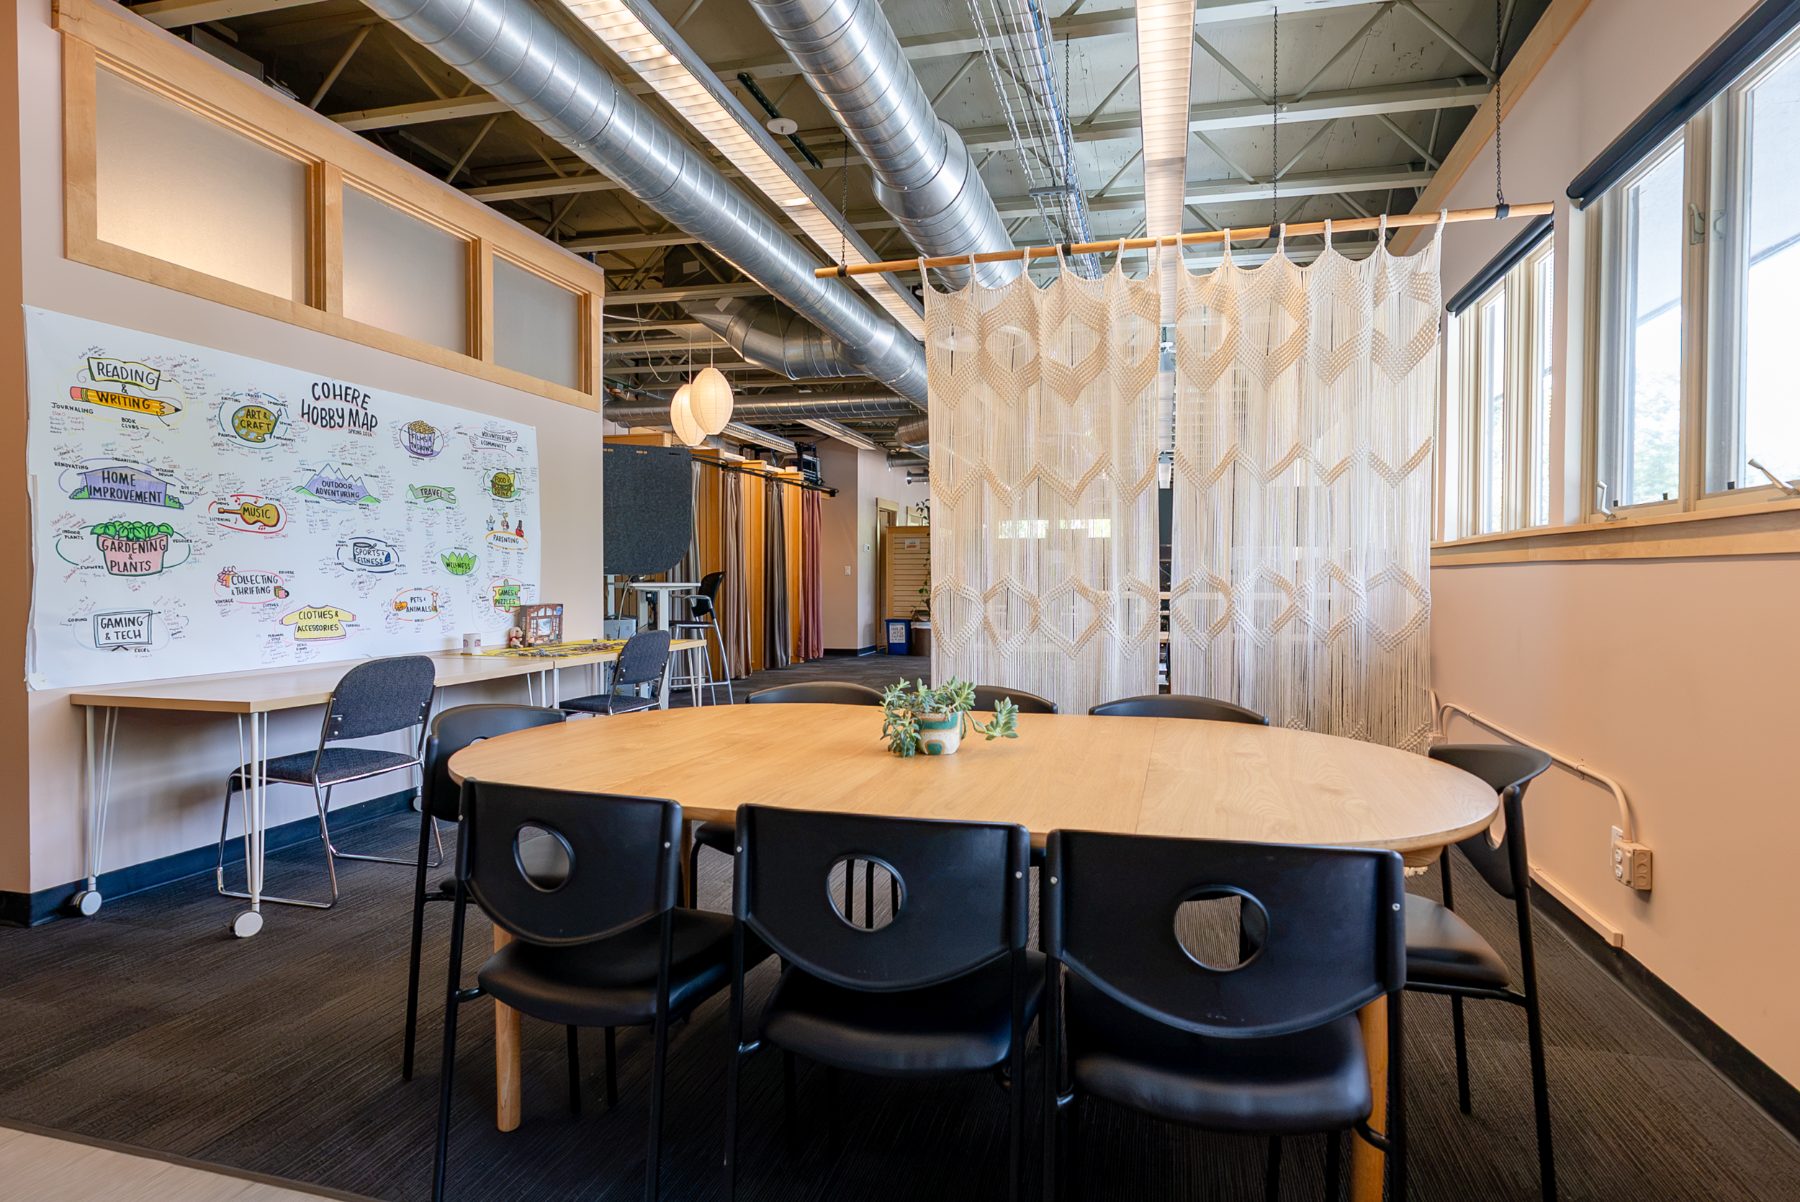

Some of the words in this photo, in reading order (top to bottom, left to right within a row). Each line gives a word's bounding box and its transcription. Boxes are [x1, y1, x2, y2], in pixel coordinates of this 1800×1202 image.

[97, 362, 156, 384] READING
[121, 384, 128, 395] &
[96, 391, 150, 410] WRITING
[312, 382, 370, 410] COHERE
[52, 402, 94, 414] JOURNALING
[246, 408, 261, 420] ART
[301, 399, 344, 428] HOBBY
[348, 408, 378, 432] MAP
[240, 420, 272, 432] CRAFT
[54, 462, 89, 470] RENOVATING
[102, 470, 136, 486] HOME
[322, 480, 353, 490] OUTDOOR
[89, 485, 162, 503] IMPROVEMENT
[316, 488, 359, 498] ADVENTURING
[420, 488, 442, 497] TRAVEL
[243, 507, 271, 519] MUSIC
[493, 535, 519, 544] PARENTING
[102, 539, 166, 554] GARDENING
[110, 560, 152, 572] PLANTS
[231, 574, 278, 585] COLLECTING
[235, 586, 270, 595] THRIFTING
[298, 610, 334, 620] CLOTHES
[100, 616, 143, 629] GAMING
[297, 624, 339, 632] ACCESSORIES
[105, 632, 111, 640] &
[114, 629, 142, 640] TECH
